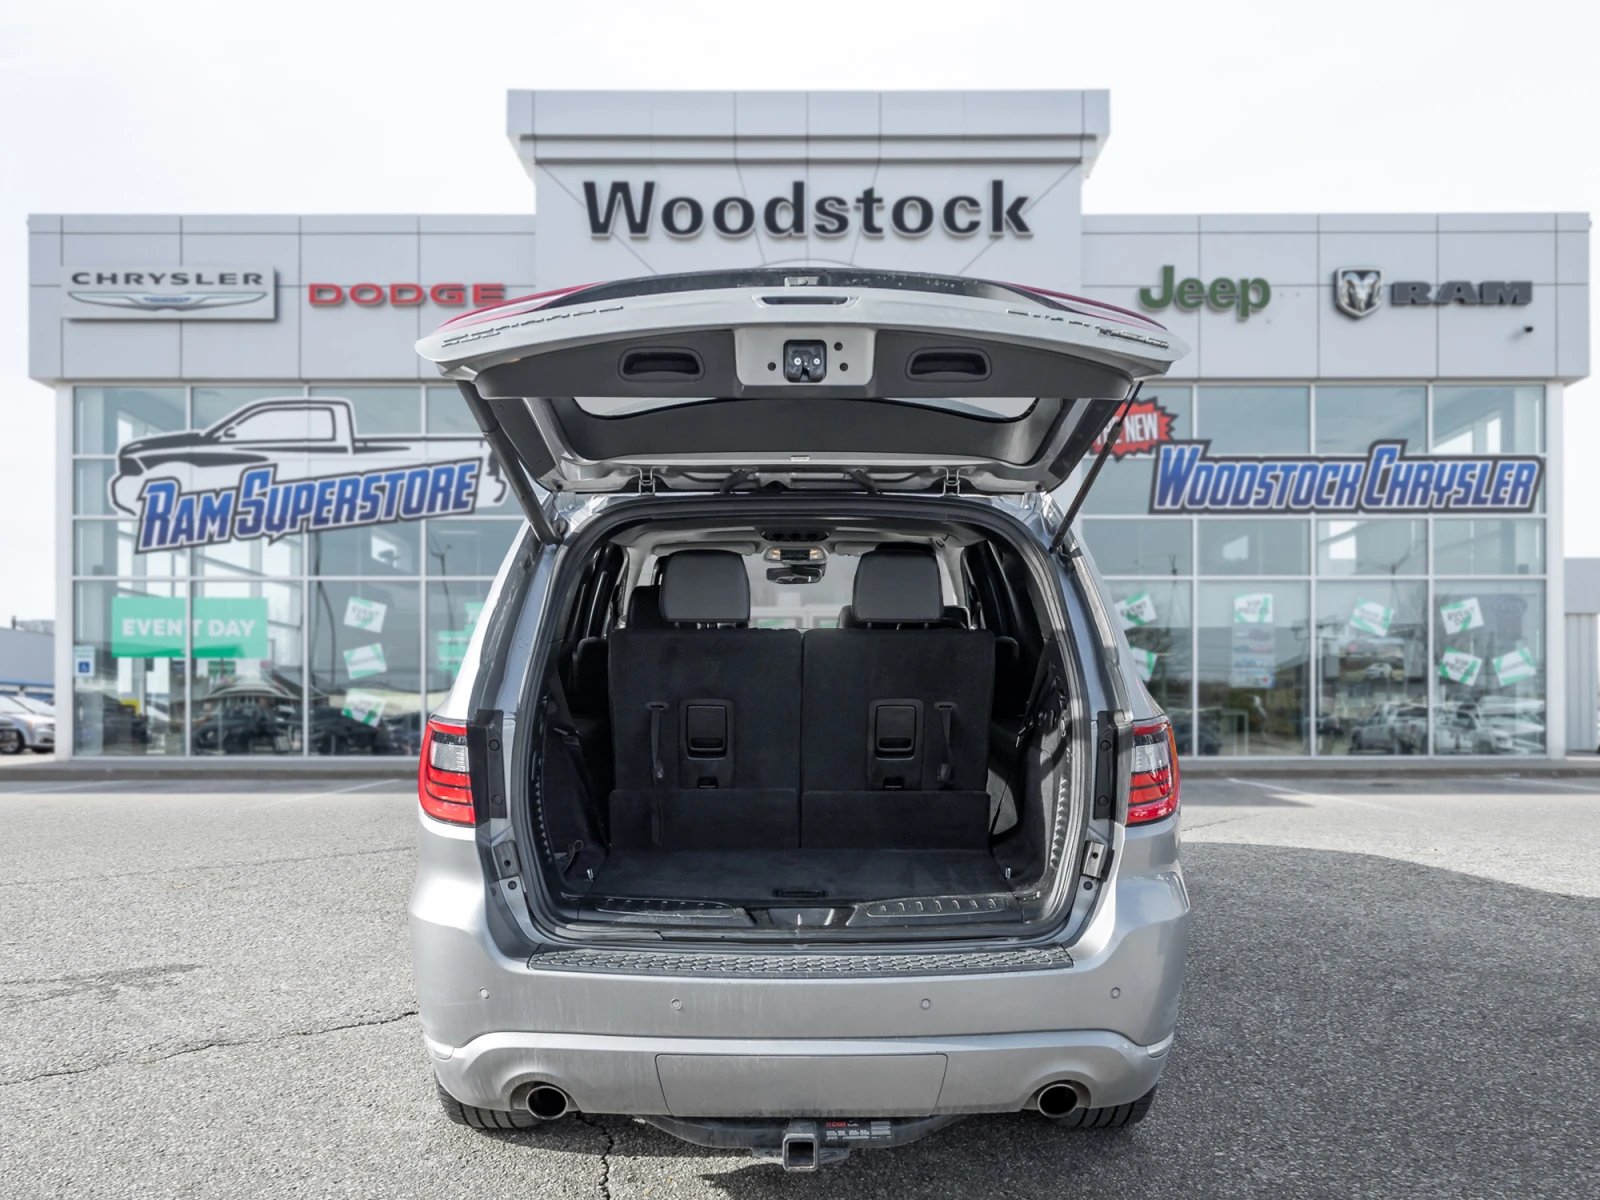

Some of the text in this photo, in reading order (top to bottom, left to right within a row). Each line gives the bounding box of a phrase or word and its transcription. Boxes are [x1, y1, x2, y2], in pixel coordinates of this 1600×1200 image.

[583, 180, 1033, 239] Woodstock
[71, 271, 264, 287] CHRYSLER
[1139, 265, 1272, 319] Jeep
[1391, 281, 1534, 307] RAM
[308, 283, 507, 308] DODGE
[1124, 413, 1159, 443] NEW
[1158, 445, 1539, 508] WOODSTOCK CHRYSLER
[138, 464, 481, 550] RAM SUPERSTORE
[121, 618, 256, 637] EVENT DAY
